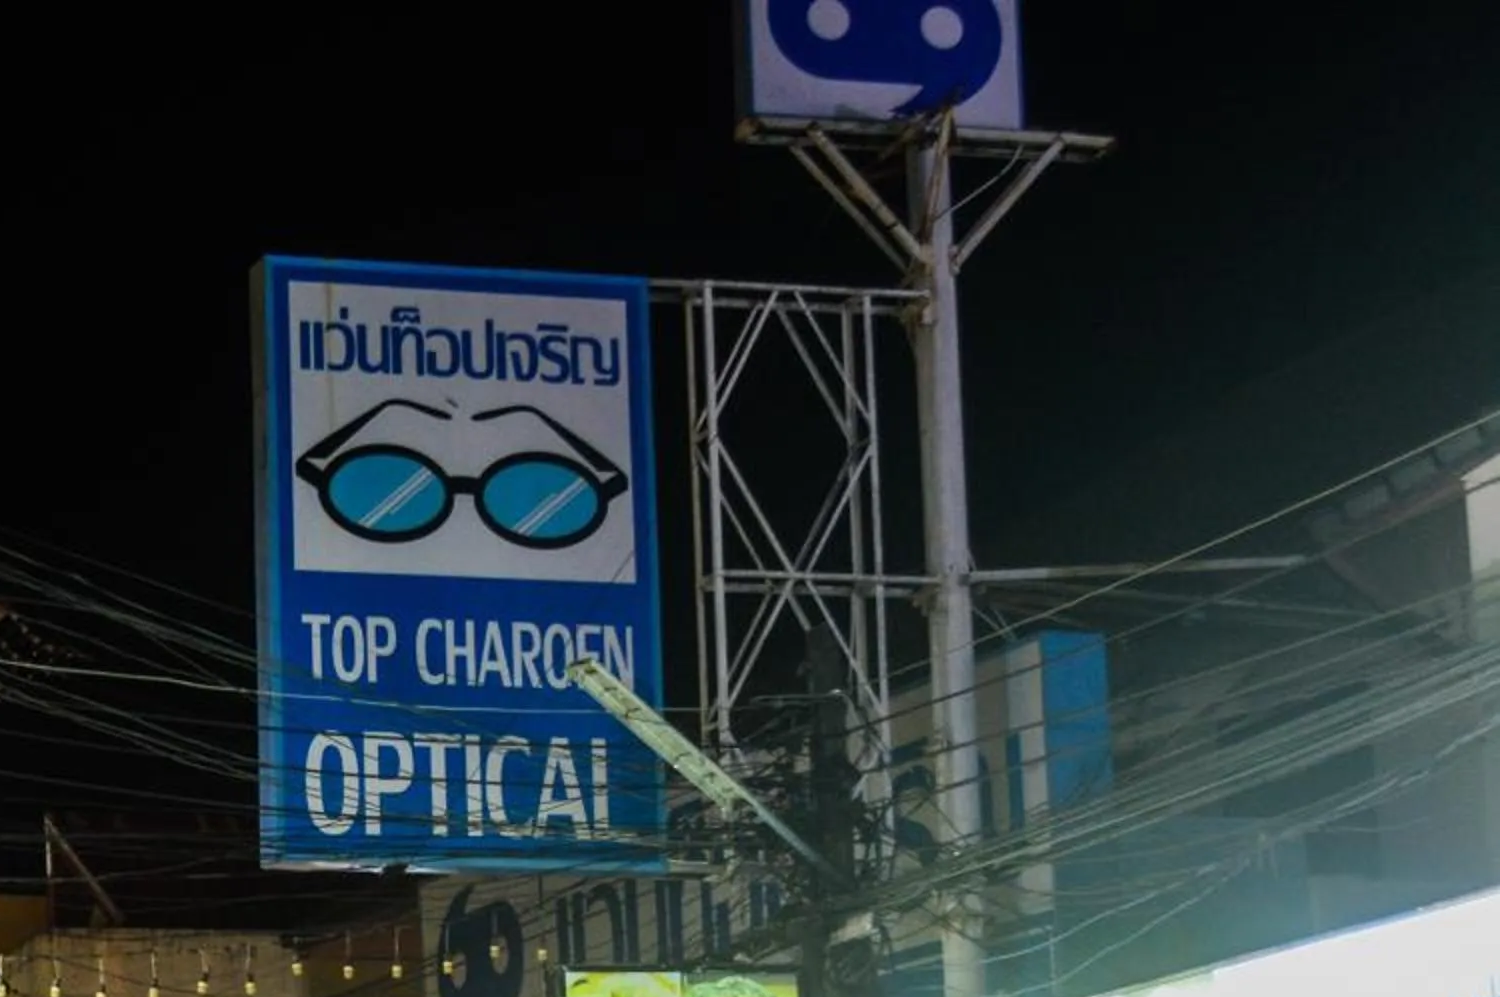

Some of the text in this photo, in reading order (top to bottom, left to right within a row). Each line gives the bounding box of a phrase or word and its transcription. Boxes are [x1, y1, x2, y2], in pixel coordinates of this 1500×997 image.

[299, 306, 620, 387] แว่นท็อปเจริญ
[301, 613, 398, 685] TOP
